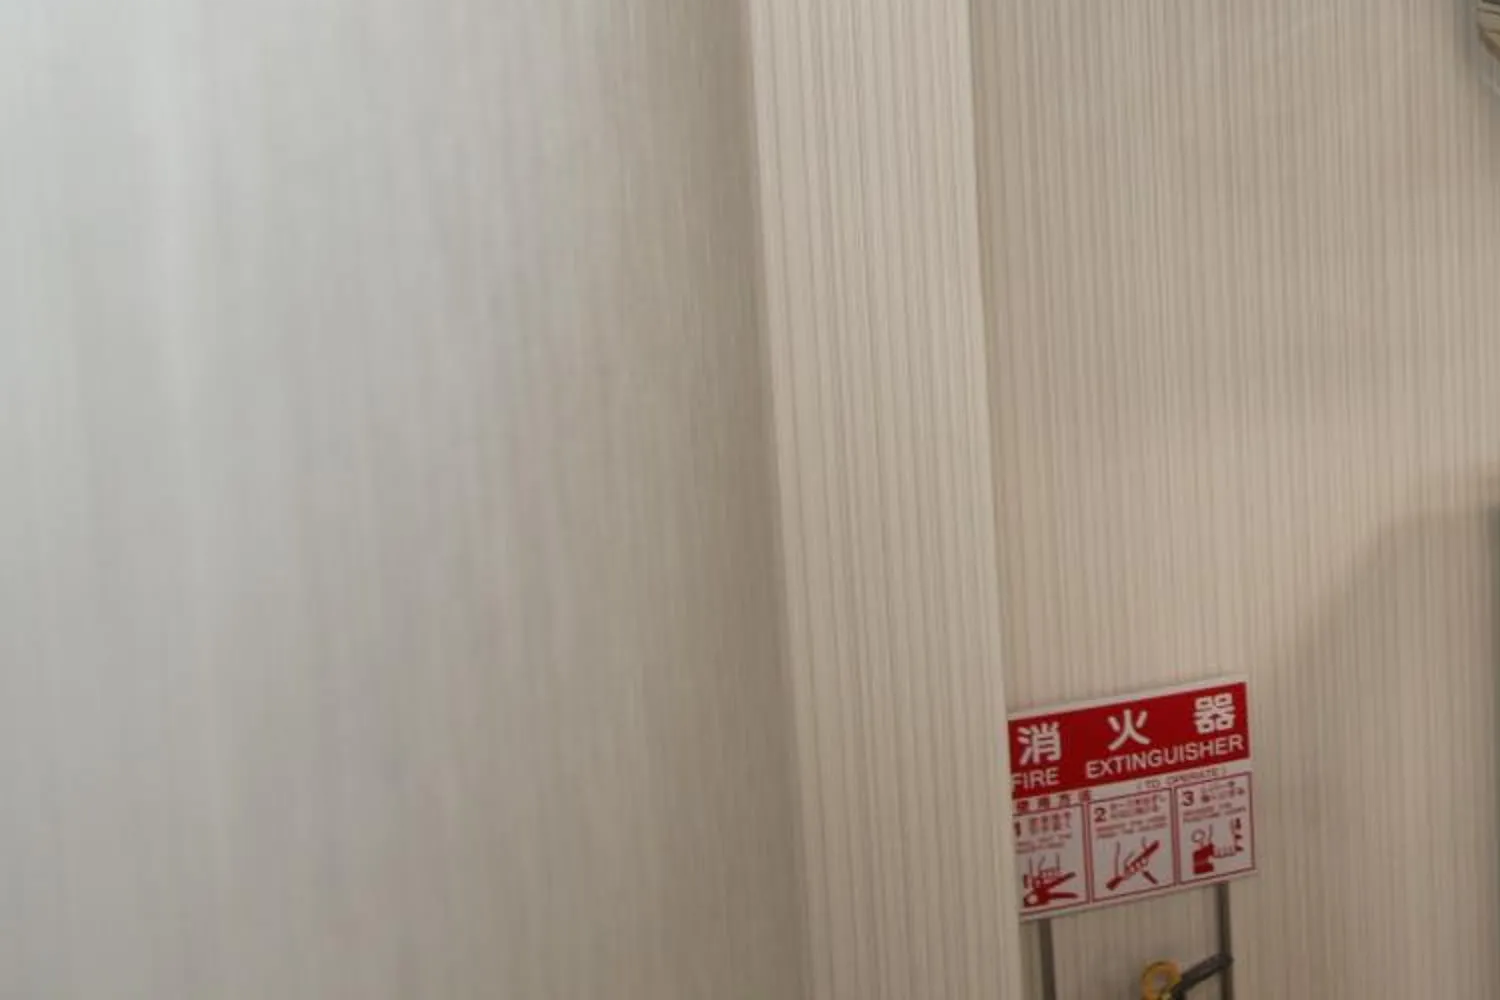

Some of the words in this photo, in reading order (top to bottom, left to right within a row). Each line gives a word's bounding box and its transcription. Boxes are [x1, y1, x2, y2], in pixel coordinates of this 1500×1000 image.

[1016, 692, 1236, 767] 消火器
[1085, 733, 1244, 780] EXTINGUISHER
[1181, 790, 1194, 807] 3
[1094, 807, 1107, 823] 2
